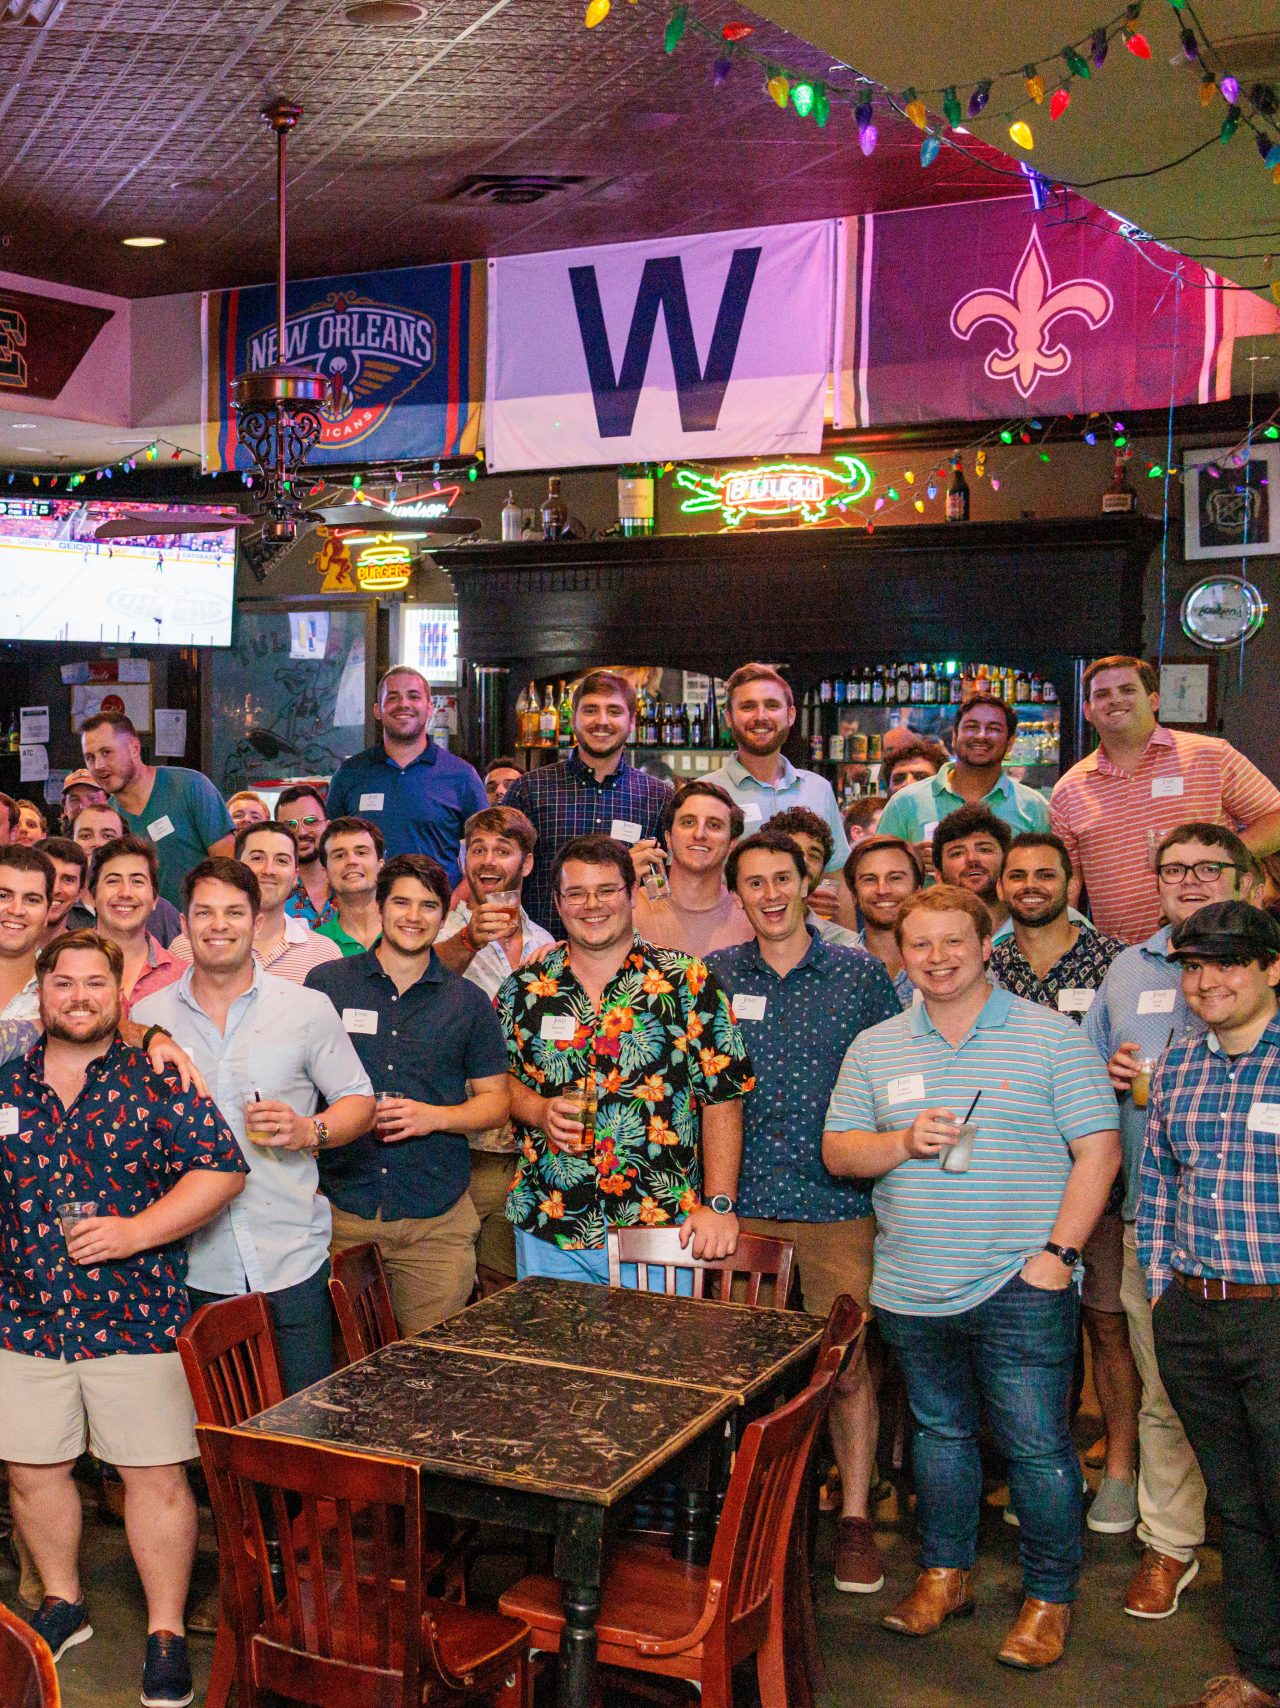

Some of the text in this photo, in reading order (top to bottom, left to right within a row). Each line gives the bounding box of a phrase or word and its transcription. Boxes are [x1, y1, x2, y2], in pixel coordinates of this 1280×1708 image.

[252, 314, 432, 372] NEW ORLEANS
[569, 246, 762, 438] W
[357, 563, 411, 580] BURGERS
